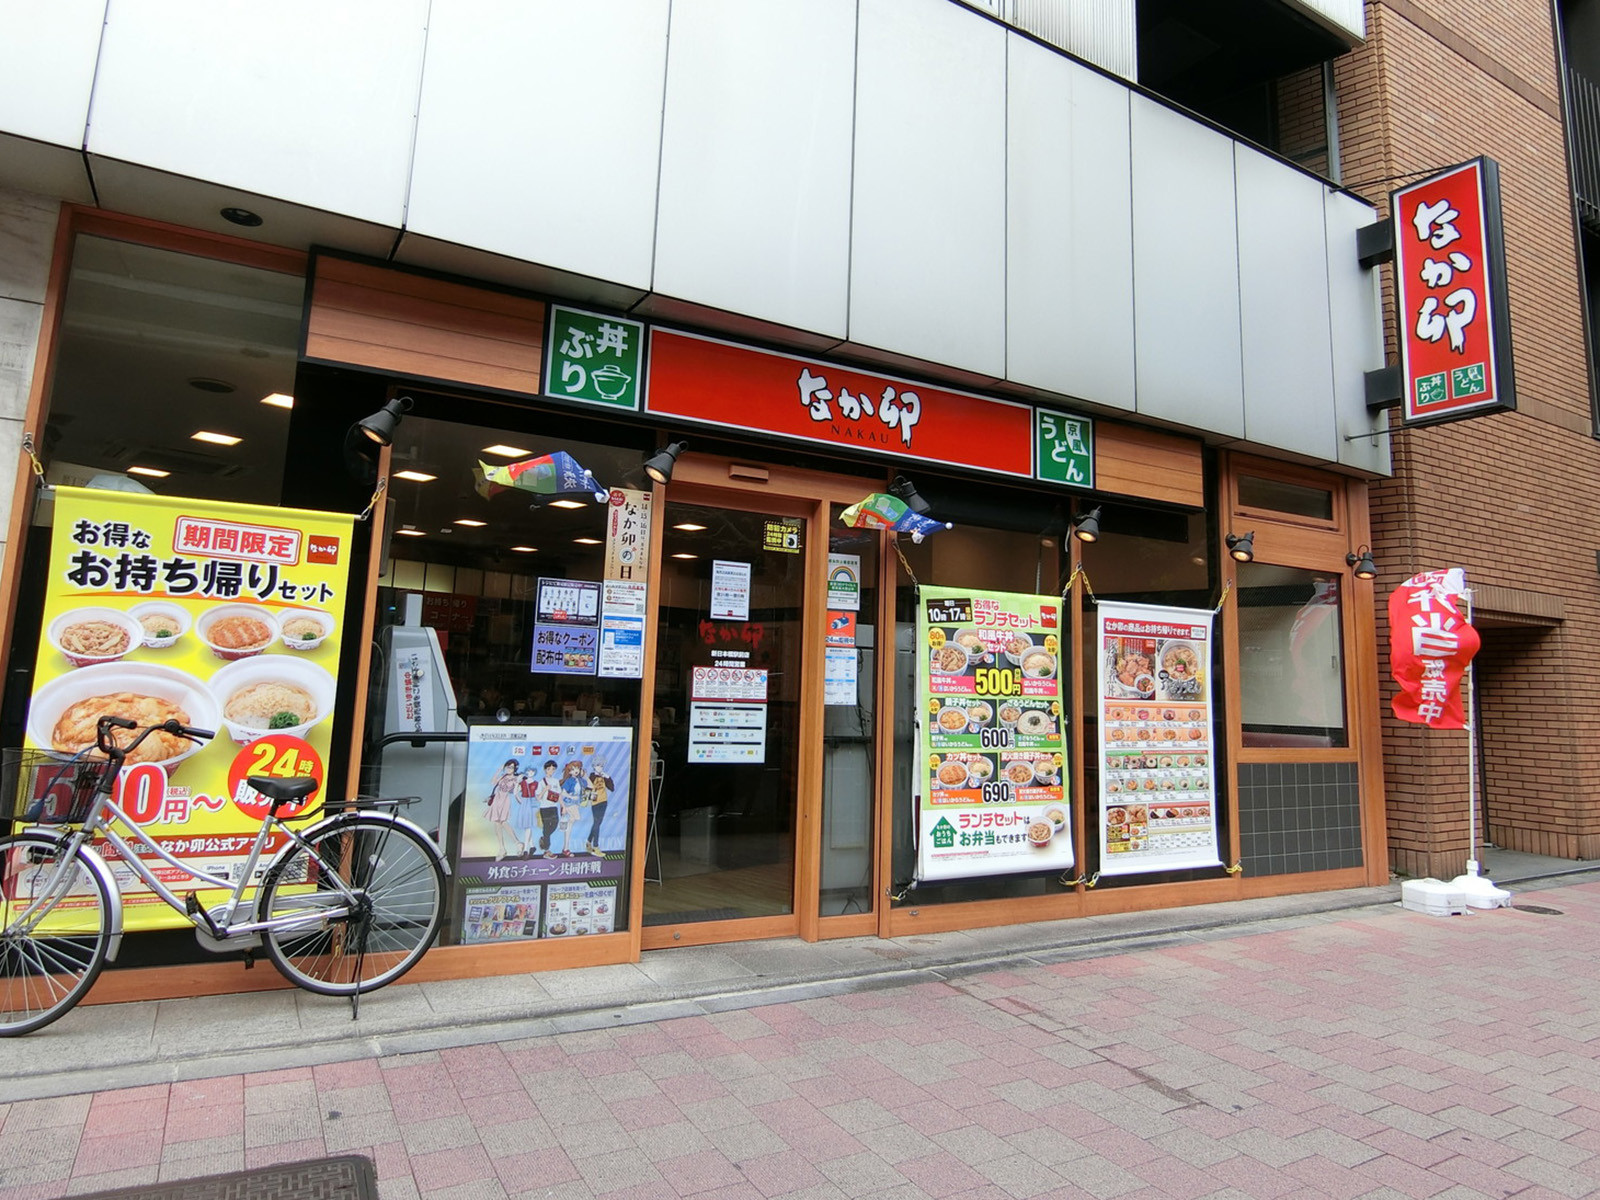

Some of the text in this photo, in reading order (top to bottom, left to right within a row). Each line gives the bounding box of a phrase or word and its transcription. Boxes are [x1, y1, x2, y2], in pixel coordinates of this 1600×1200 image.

[1413, 199, 1477, 354] なか卯
[797, 366, 921, 448] なか卯
[830, 424, 890, 444] NAKAU
[1041, 416, 1084, 482] うどん
[72, 519, 151, 549] お得な
[182, 523, 295, 559] 期間限定
[67, 550, 335, 604] お持ち帰りセット
[973, 599, 999, 611] お得な
[974, 609, 1039, 629] ランチセット
[537, 630, 596, 647] お得なクーポン
[700, 619, 764, 649] なか卯
[536, 649, 564, 666] 配布中
[959, 811, 1030, 829] ランチセットは
[487, 861, 602, 880] 外食5チェーン共同作戦
